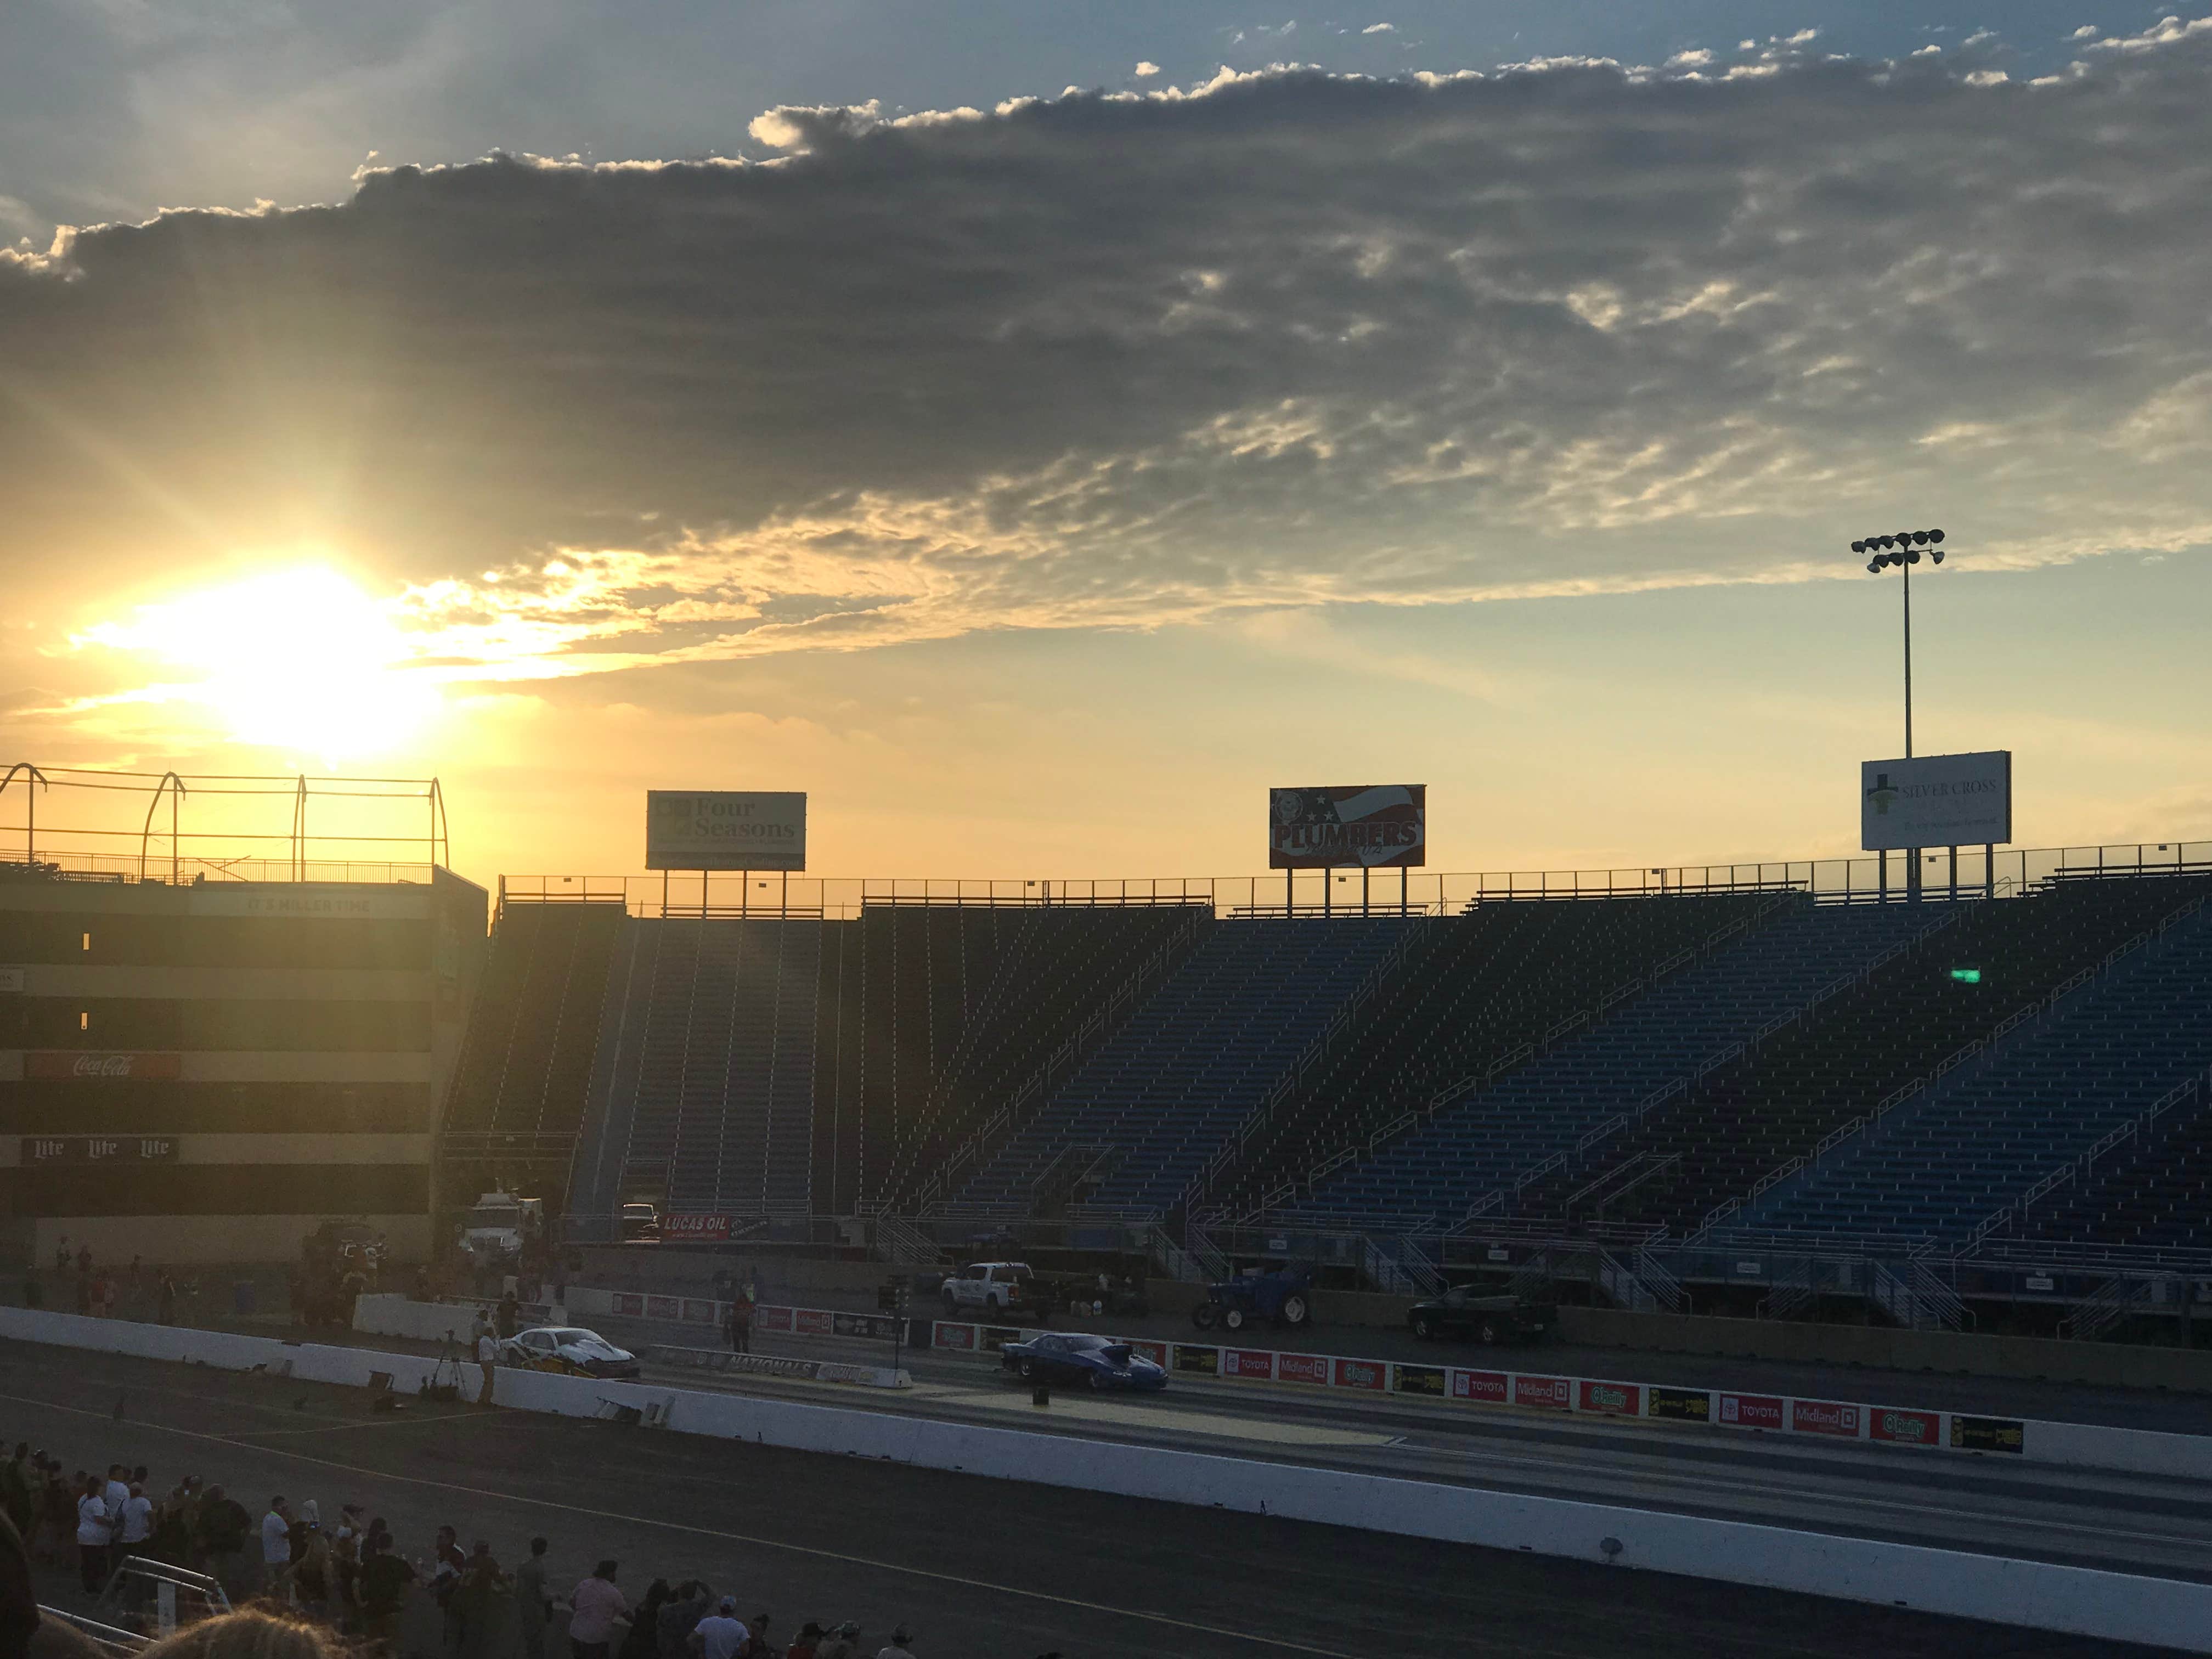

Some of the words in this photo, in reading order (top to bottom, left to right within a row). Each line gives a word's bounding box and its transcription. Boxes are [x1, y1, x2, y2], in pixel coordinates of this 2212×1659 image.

[1903, 782, 1949, 799] SILVER
[1952, 779, 1997, 794] CROSS
[696, 798, 755, 817] Four
[695, 819, 795, 838] Seasons
[1274, 822, 1418, 849] PLUMBERS
[248, 898, 274, 911] IT'S
[279, 899, 332, 912] MILLER
[335, 900, 371, 912] TIME
[35, 1141, 65, 1159] Lite
[88, 1140, 118, 1159] Lite
[140, 1140, 170, 1159] Lite
[663, 1217, 704, 1230] LUCAS
[707, 1217, 726, 1230] OIL
[1242, 1360, 1269, 1370] TOYOTA
[1281, 1361, 1313, 1374] Midland
[1472, 1381, 1504, 1393] TOYOTA
[1518, 1383, 1553, 1396] Midland
[1741, 1405, 1779, 1419] TOYOTA
[1796, 1408, 1839, 1424] Midland
